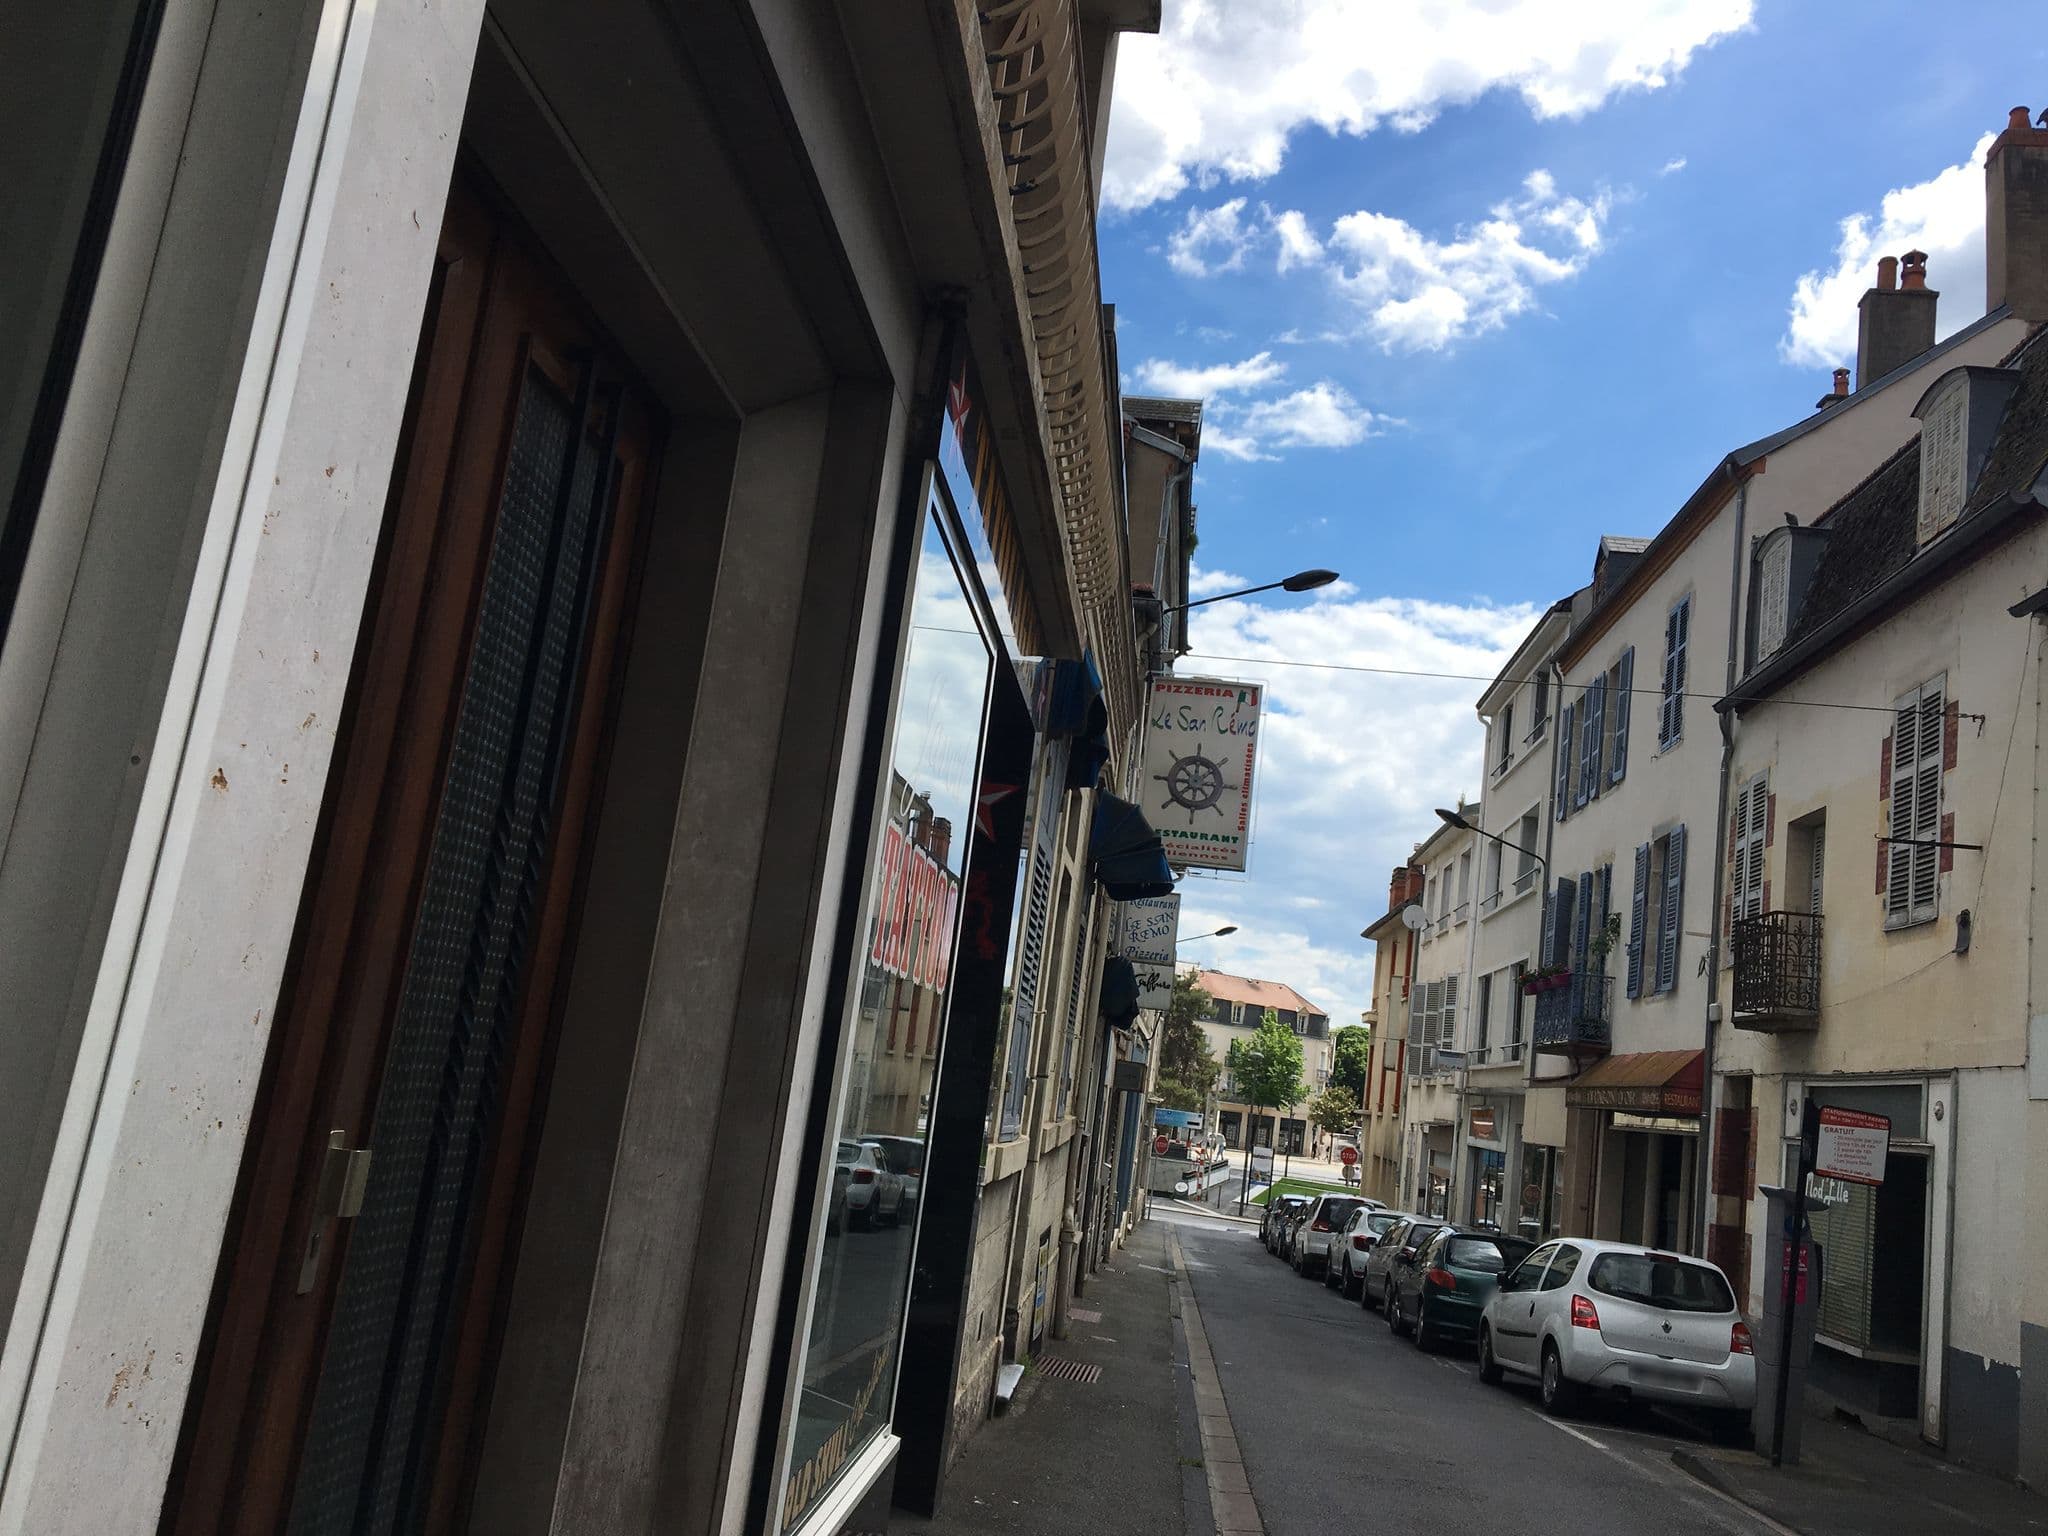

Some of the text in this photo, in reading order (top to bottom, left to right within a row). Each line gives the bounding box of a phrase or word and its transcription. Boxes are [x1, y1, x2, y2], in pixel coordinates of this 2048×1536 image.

[1155, 684, 1235, 698] PIZZERIA
[1151, 703, 1172, 730] Le
[1177, 705, 1207, 732] San
[1237, 802, 1248, 832] Salles
[1164, 842, 1238, 855] écialités
[1167, 849, 1228, 860] liennes
[871, 818, 959, 995] TATTOO
[1128, 925, 1170, 943] REMO
[1124, 945, 1170, 961] Pizzeria
[1824, 1126, 1855, 1135] GRATUIT
[1342, 1151, 1357, 1160] STOP
